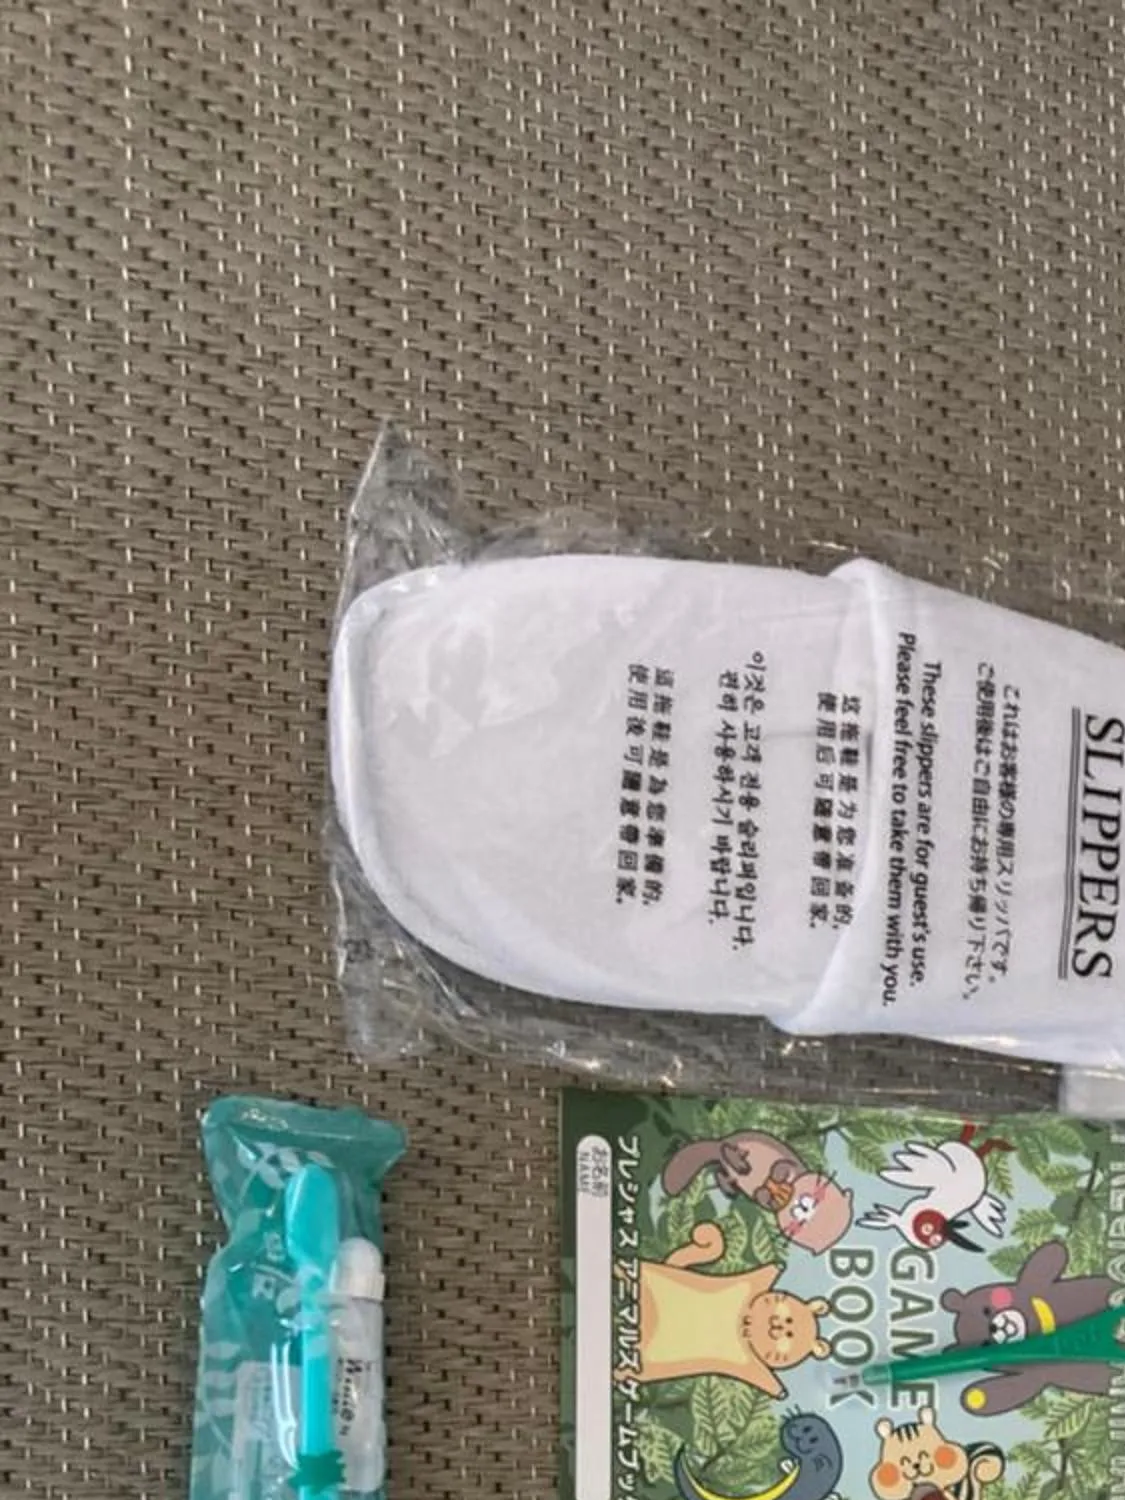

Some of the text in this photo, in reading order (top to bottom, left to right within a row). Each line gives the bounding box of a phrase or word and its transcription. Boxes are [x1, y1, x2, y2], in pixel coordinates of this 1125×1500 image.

[741, 720, 763, 764] 고객
[744, 650, 767, 715] 이것은
[710, 718, 738, 825] 사용하시기
[738, 771, 763, 812] 전용
[879, 632, 917, 1008] Please feel free to take them with you.
[909, 662, 942, 988] These slippers are for guest's use.
[707, 834, 734, 925] 바랍니다.
[1071, 714, 1125, 979] SLIPPERS
[829, 1250, 875, 1406] BOOK
[889, 1250, 935, 1408] GAME
